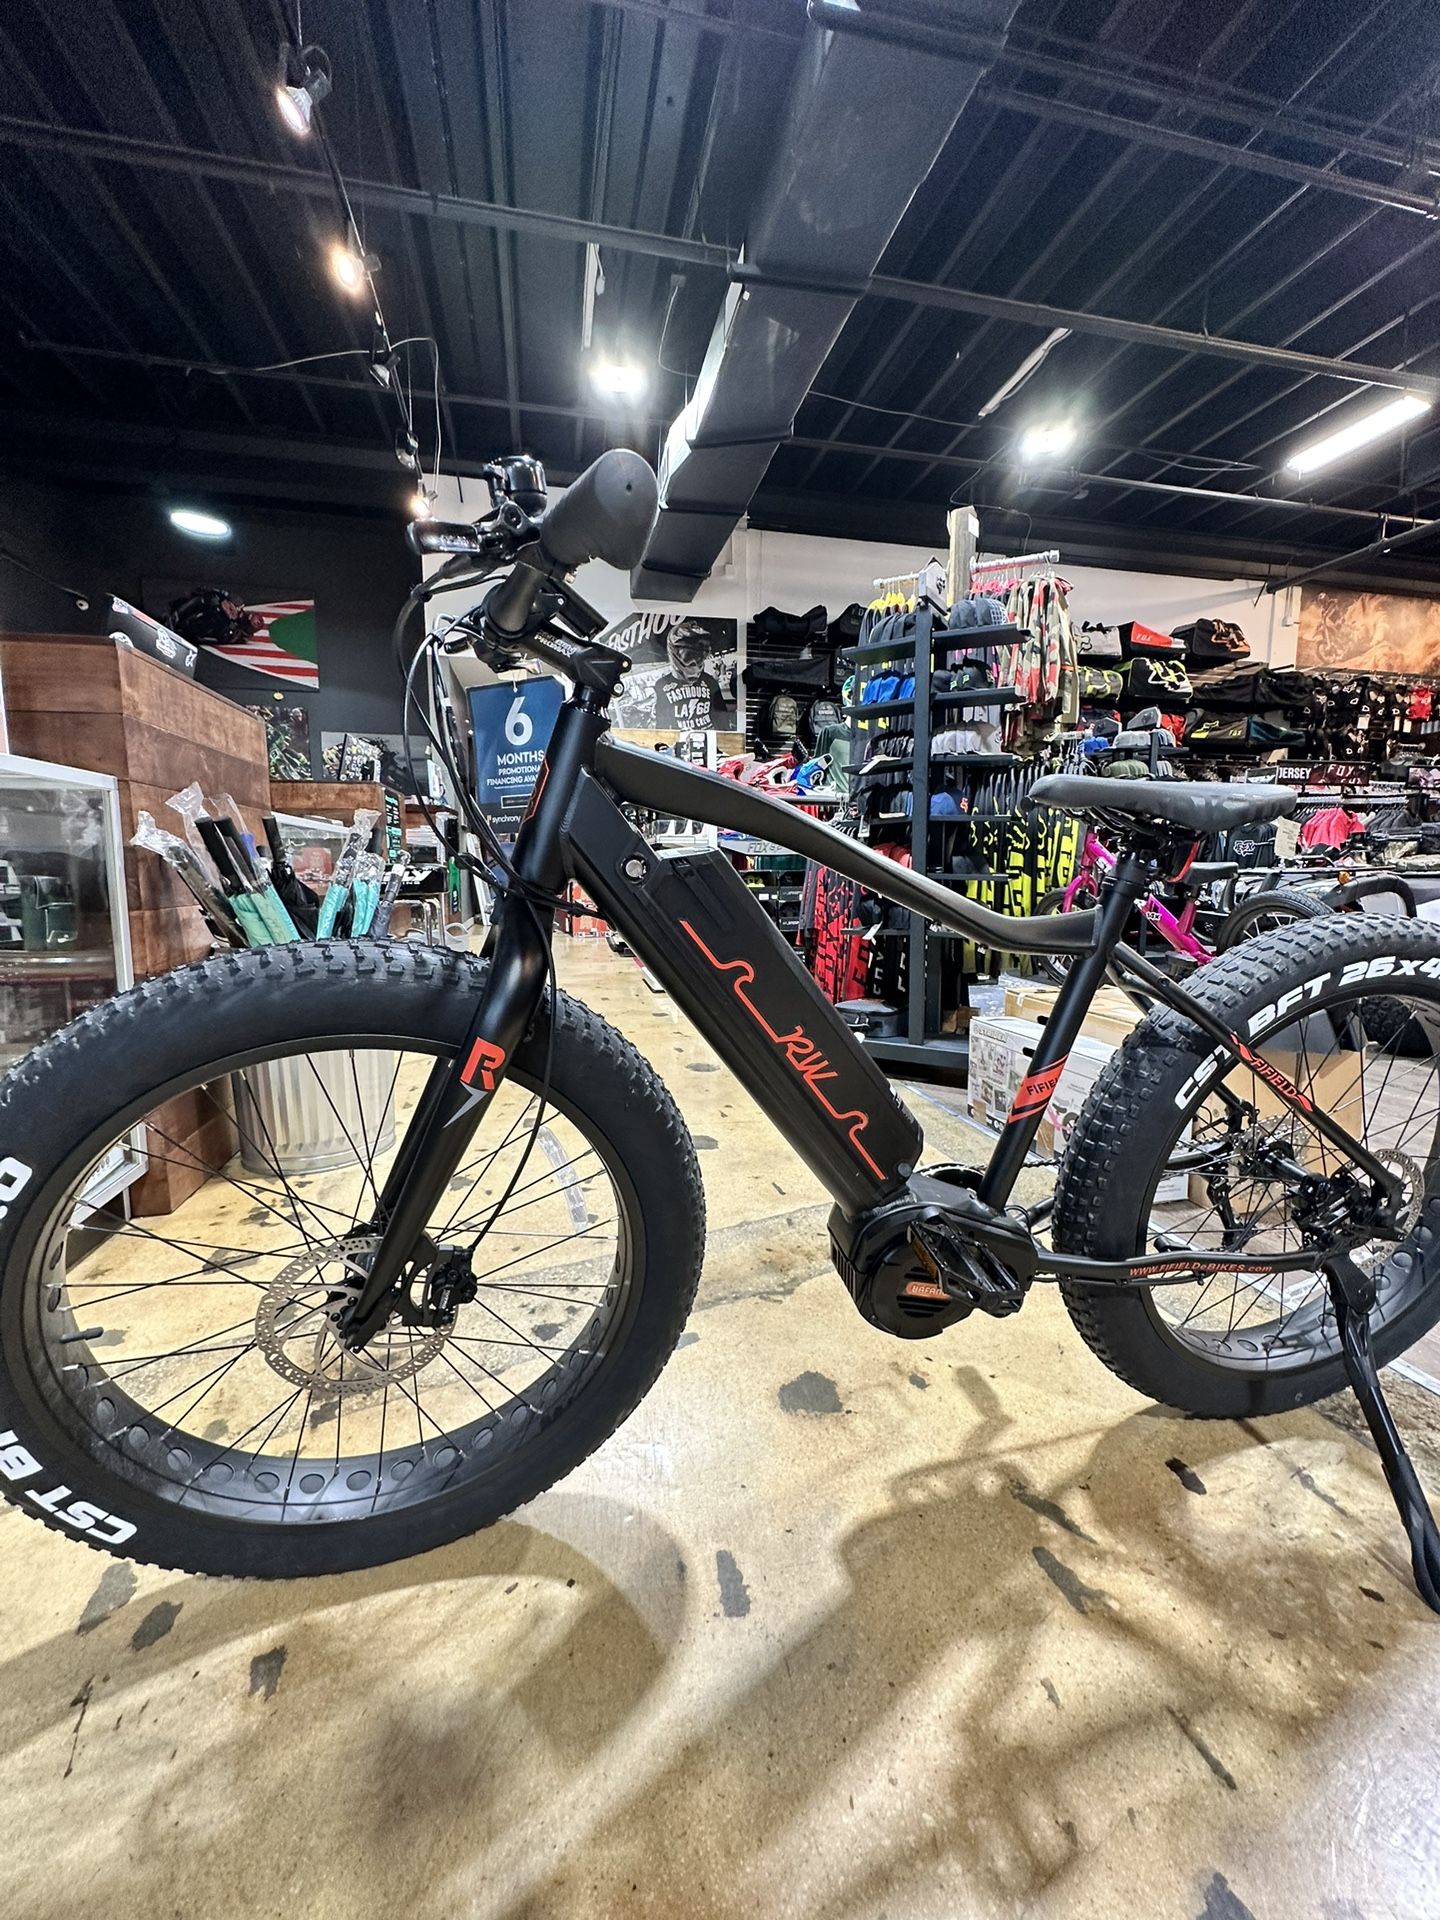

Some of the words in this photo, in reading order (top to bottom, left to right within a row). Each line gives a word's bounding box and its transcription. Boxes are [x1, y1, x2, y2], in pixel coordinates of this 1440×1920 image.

[604, 613, 685, 651] FASTHO
[666, 685, 711, 704] FASTHOUSE
[674, 705, 689, 718] LA
[696, 701, 711, 715] 68
[505, 696, 533, 746] 6
[497, 750, 545, 766] MONTHS
[498, 764, 541, 775] PROMOTIONA
[1278, 767, 1312, 779] JERSEY
[1327, 763, 1354, 778] FOX
[486, 777, 522, 786] FINANCING
[492, 813, 521, 825] synchrony
[747, 842, 769, 854] FOX
[1247, 972, 1332, 1038] BFT
[459, 1036, 507, 1090] R
[1026, 1077, 1060, 1096] FIFIE
[1251, 1057, 1298, 1099] FIFIELD
[24, 1486, 138, 1546] CST
